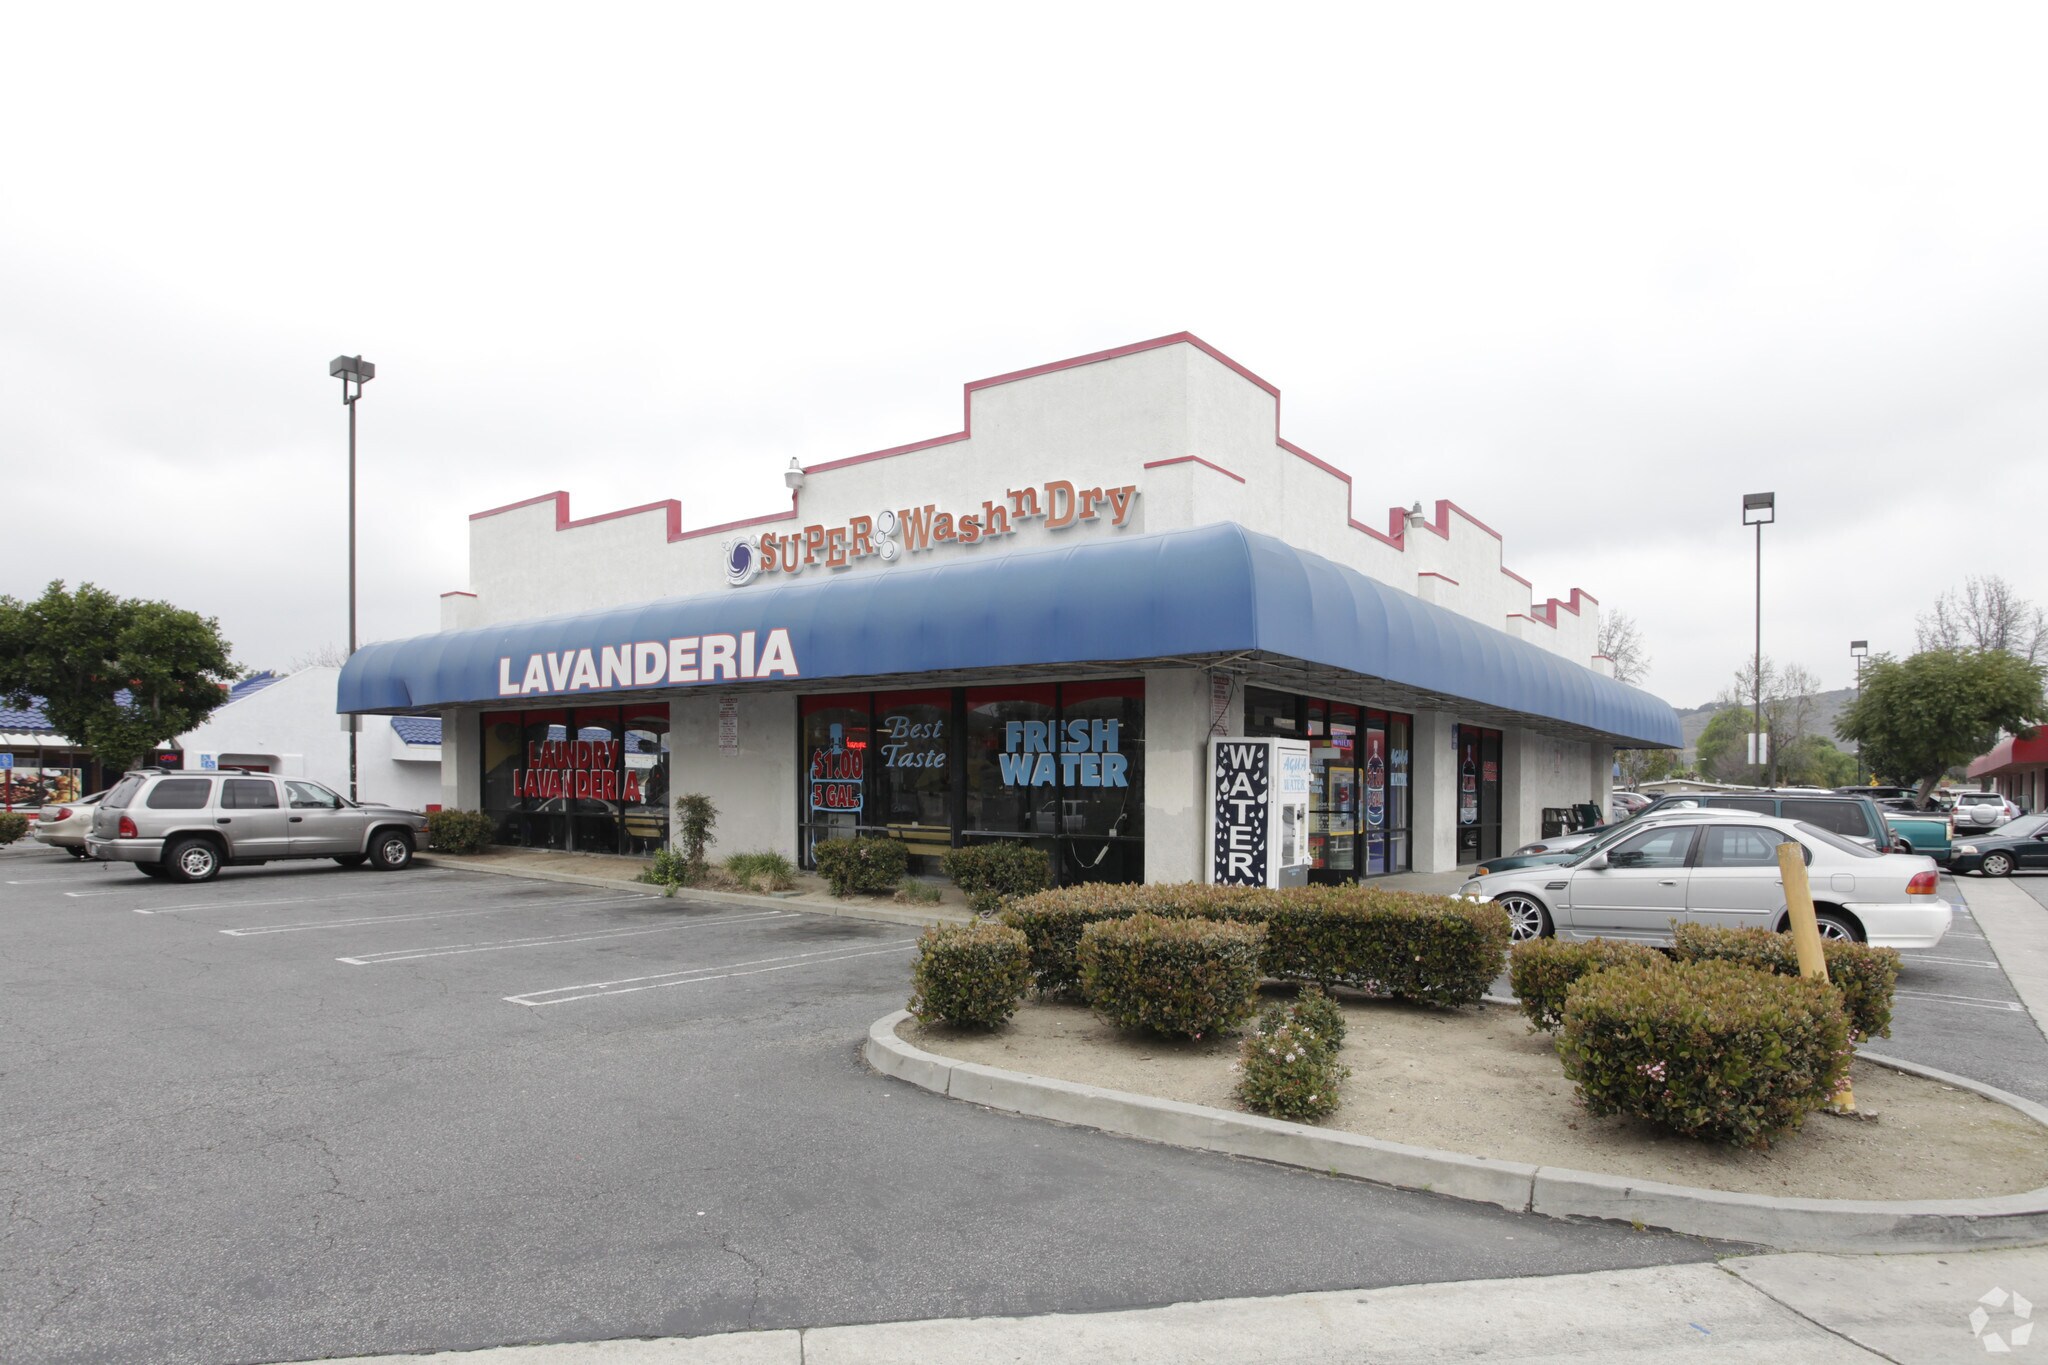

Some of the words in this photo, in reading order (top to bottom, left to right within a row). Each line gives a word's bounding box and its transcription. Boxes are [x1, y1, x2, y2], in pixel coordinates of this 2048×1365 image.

[760, 514, 876, 575] SUPER
[898, 500, 1014, 552] Wash
[1044, 479, 1140, 530] Dry
[498, 628, 800, 696] LAVANDERIA
[884, 715, 944, 740] Best
[528, 739, 620, 769] LAUNDRY
[813, 748, 863, 780] $1.00
[880, 741, 948, 768] Taste
[998, 752, 1129, 787] WATER
[1283, 756, 1308, 773] AGUA
[513, 768, 641, 803] LAVANDERIA
[814, 785, 823, 806] 5
[826, 784, 859, 807] GAL.
[1284, 778, 1307, 791] WATER
[1228, 744, 1257, 878] WATER
